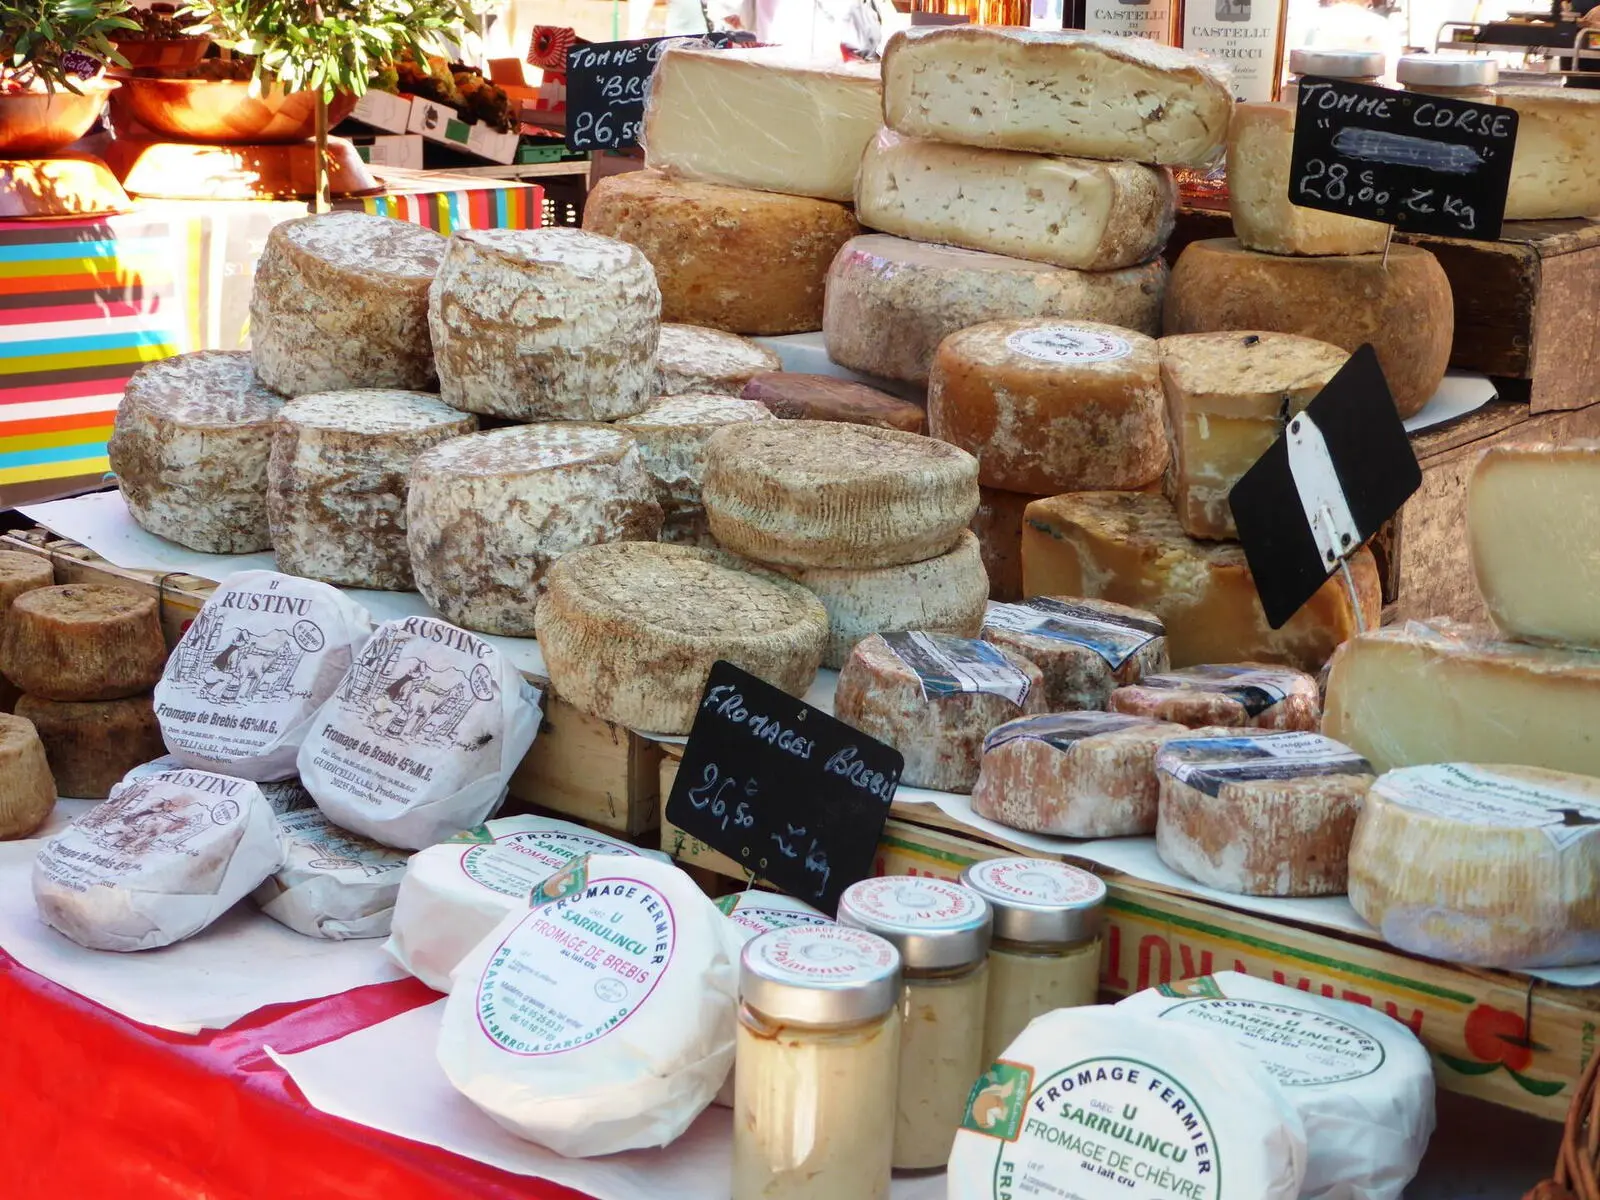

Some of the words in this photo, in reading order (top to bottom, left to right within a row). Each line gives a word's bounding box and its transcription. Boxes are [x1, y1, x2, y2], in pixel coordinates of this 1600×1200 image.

[1413, 103, 1511, 138] CORSE
[220, 592, 313, 617] RUSTINU
[400, 616, 494, 659] RUSTINU
[156, 703, 198, 724] Fromage
[199, 711, 210, 722] de
[210, 712, 238, 729] Brebis
[322, 724, 360, 752] Fromage
[358, 740, 370, 756] de
[370, 747, 400, 769] Brebis
[505, 841, 564, 868] FROMAGE
[515, 832, 608, 849] FROMAGE
[544, 885, 638, 917] FROMAGE
[639, 894, 670, 966] FERMIER
[561, 908, 648, 956] SARRULINCU
[610, 912, 624, 924] U
[532, 918, 588, 953] FROMAGE
[584, 944, 600, 962] DE
[602, 952, 650, 984] BREBIS
[560, 948, 571, 958] au
[570, 952, 584, 966] lait
[584, 960, 597, 970] cru
[542, 1008, 628, 1052] CARCOPINO
[1188, 1008, 1271, 1040] FROMAGE
[1200, 1000, 1304, 1017] FROMAGE
[1314, 1015, 1376, 1053] FERMIER
[1223, 1009, 1351, 1046] SARRULINCU
[1286, 1018, 1302, 1026] U
[1035, 1066, 1140, 1112] FROMAGE
[1148, 1078, 1212, 1175] FERMIER
[1122, 1104, 1138, 1121] U
[1060, 1102, 1188, 1164] SARRULINCU
[1024, 1118, 1109, 1163] FROMAGE
[1107, 1150, 1134, 1172] DE
[1134, 1164, 1207, 1200] CHÈVRE
[1080, 1160, 1094, 1174] au
[1096, 1164, 1115, 1182] lait
[1116, 1174, 1136, 1188] cru
